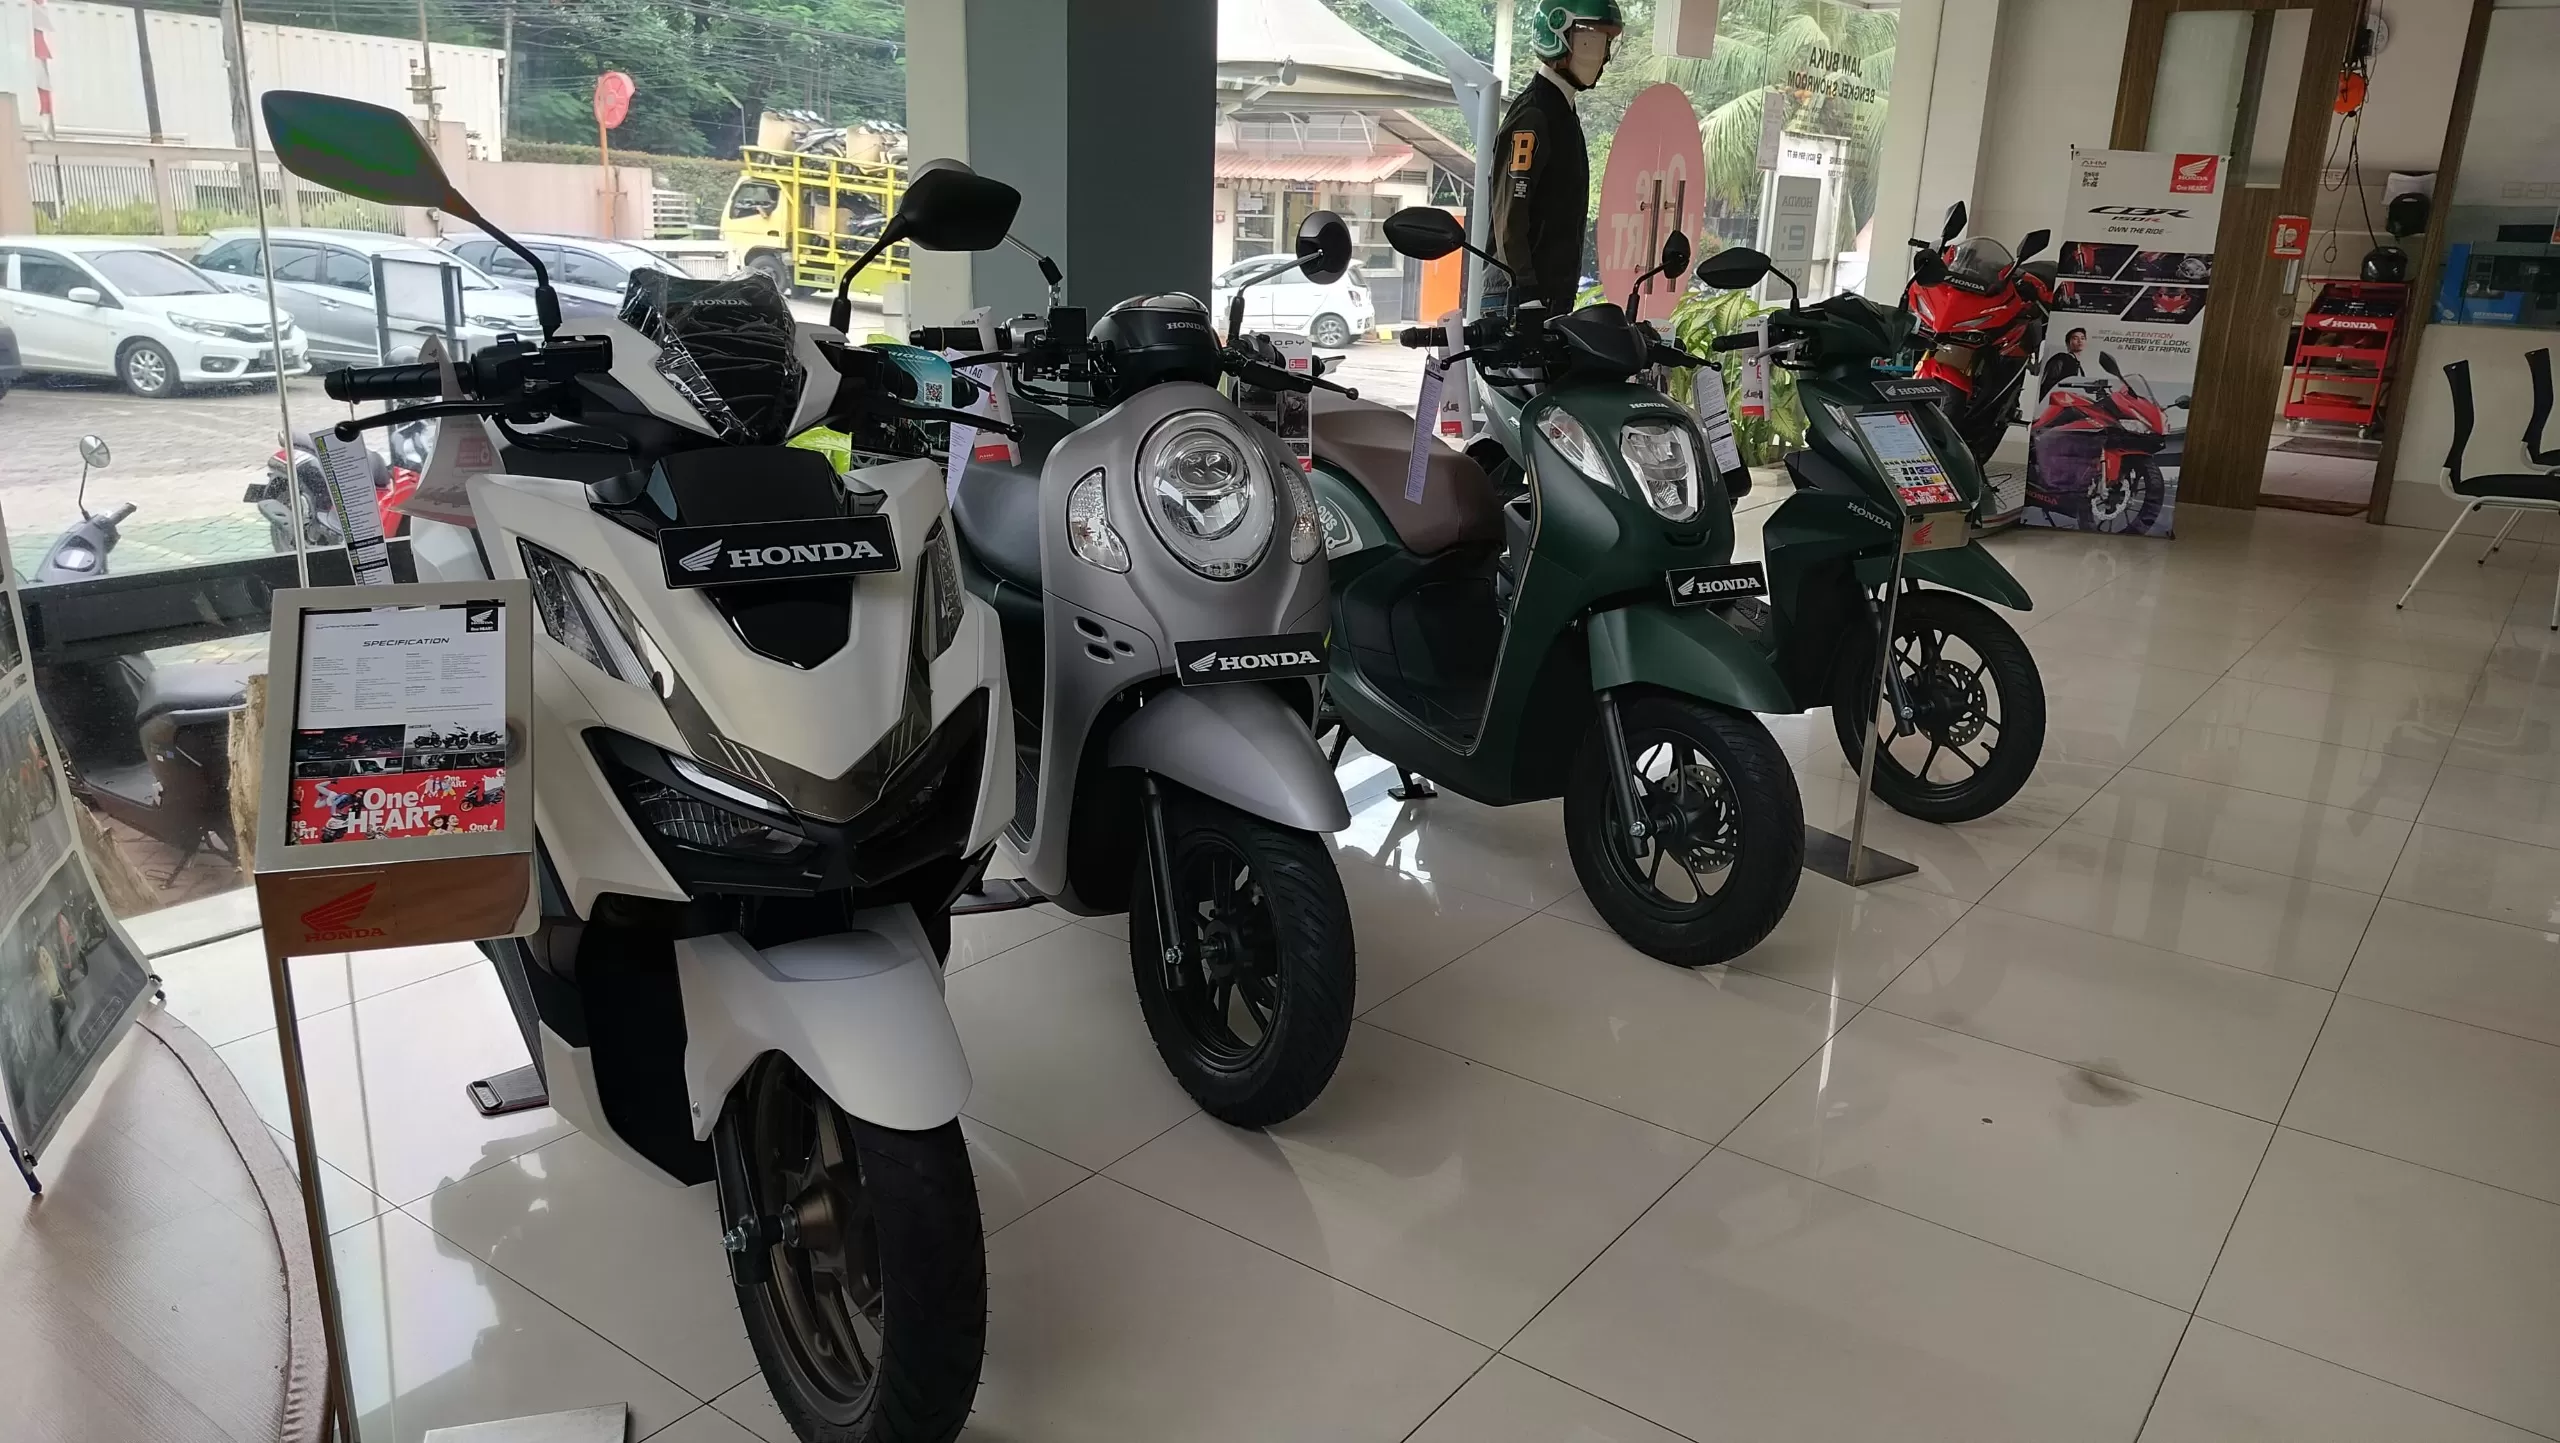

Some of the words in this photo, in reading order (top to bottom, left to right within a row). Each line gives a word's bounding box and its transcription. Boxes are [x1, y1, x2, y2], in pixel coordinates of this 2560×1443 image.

[1510, 132, 1535, 171] B
[2088, 206, 2194, 219] CBR
[2108, 225, 2128, 233] OWN
[1951, 277, 1986, 292] HONDA
[692, 298, 749, 306] HONDA
[1166, 322, 1208, 333] HONDA
[2331, 320, 2378, 332] HONDA
[2103, 336, 2161, 345] AGGRESSIVE
[2125, 330, 2174, 339] ATTENTION
[2124, 343, 2146, 351] NEW
[2147, 345, 2191, 353] STRIPING
[1897, 385, 1942, 395] HONDA
[1847, 502, 1892, 530] HONDA
[727, 540, 883, 568] HONDA
[1697, 577, 1761, 594] HONDA
[362, 637, 450, 647] SPECIFICATION
[1217, 650, 1321, 671] HONDA
[362, 787, 419, 810] One
[347, 805, 442, 834] HEART
[469, 823, 488, 833] One
[304, 927, 388, 942] HONDA
